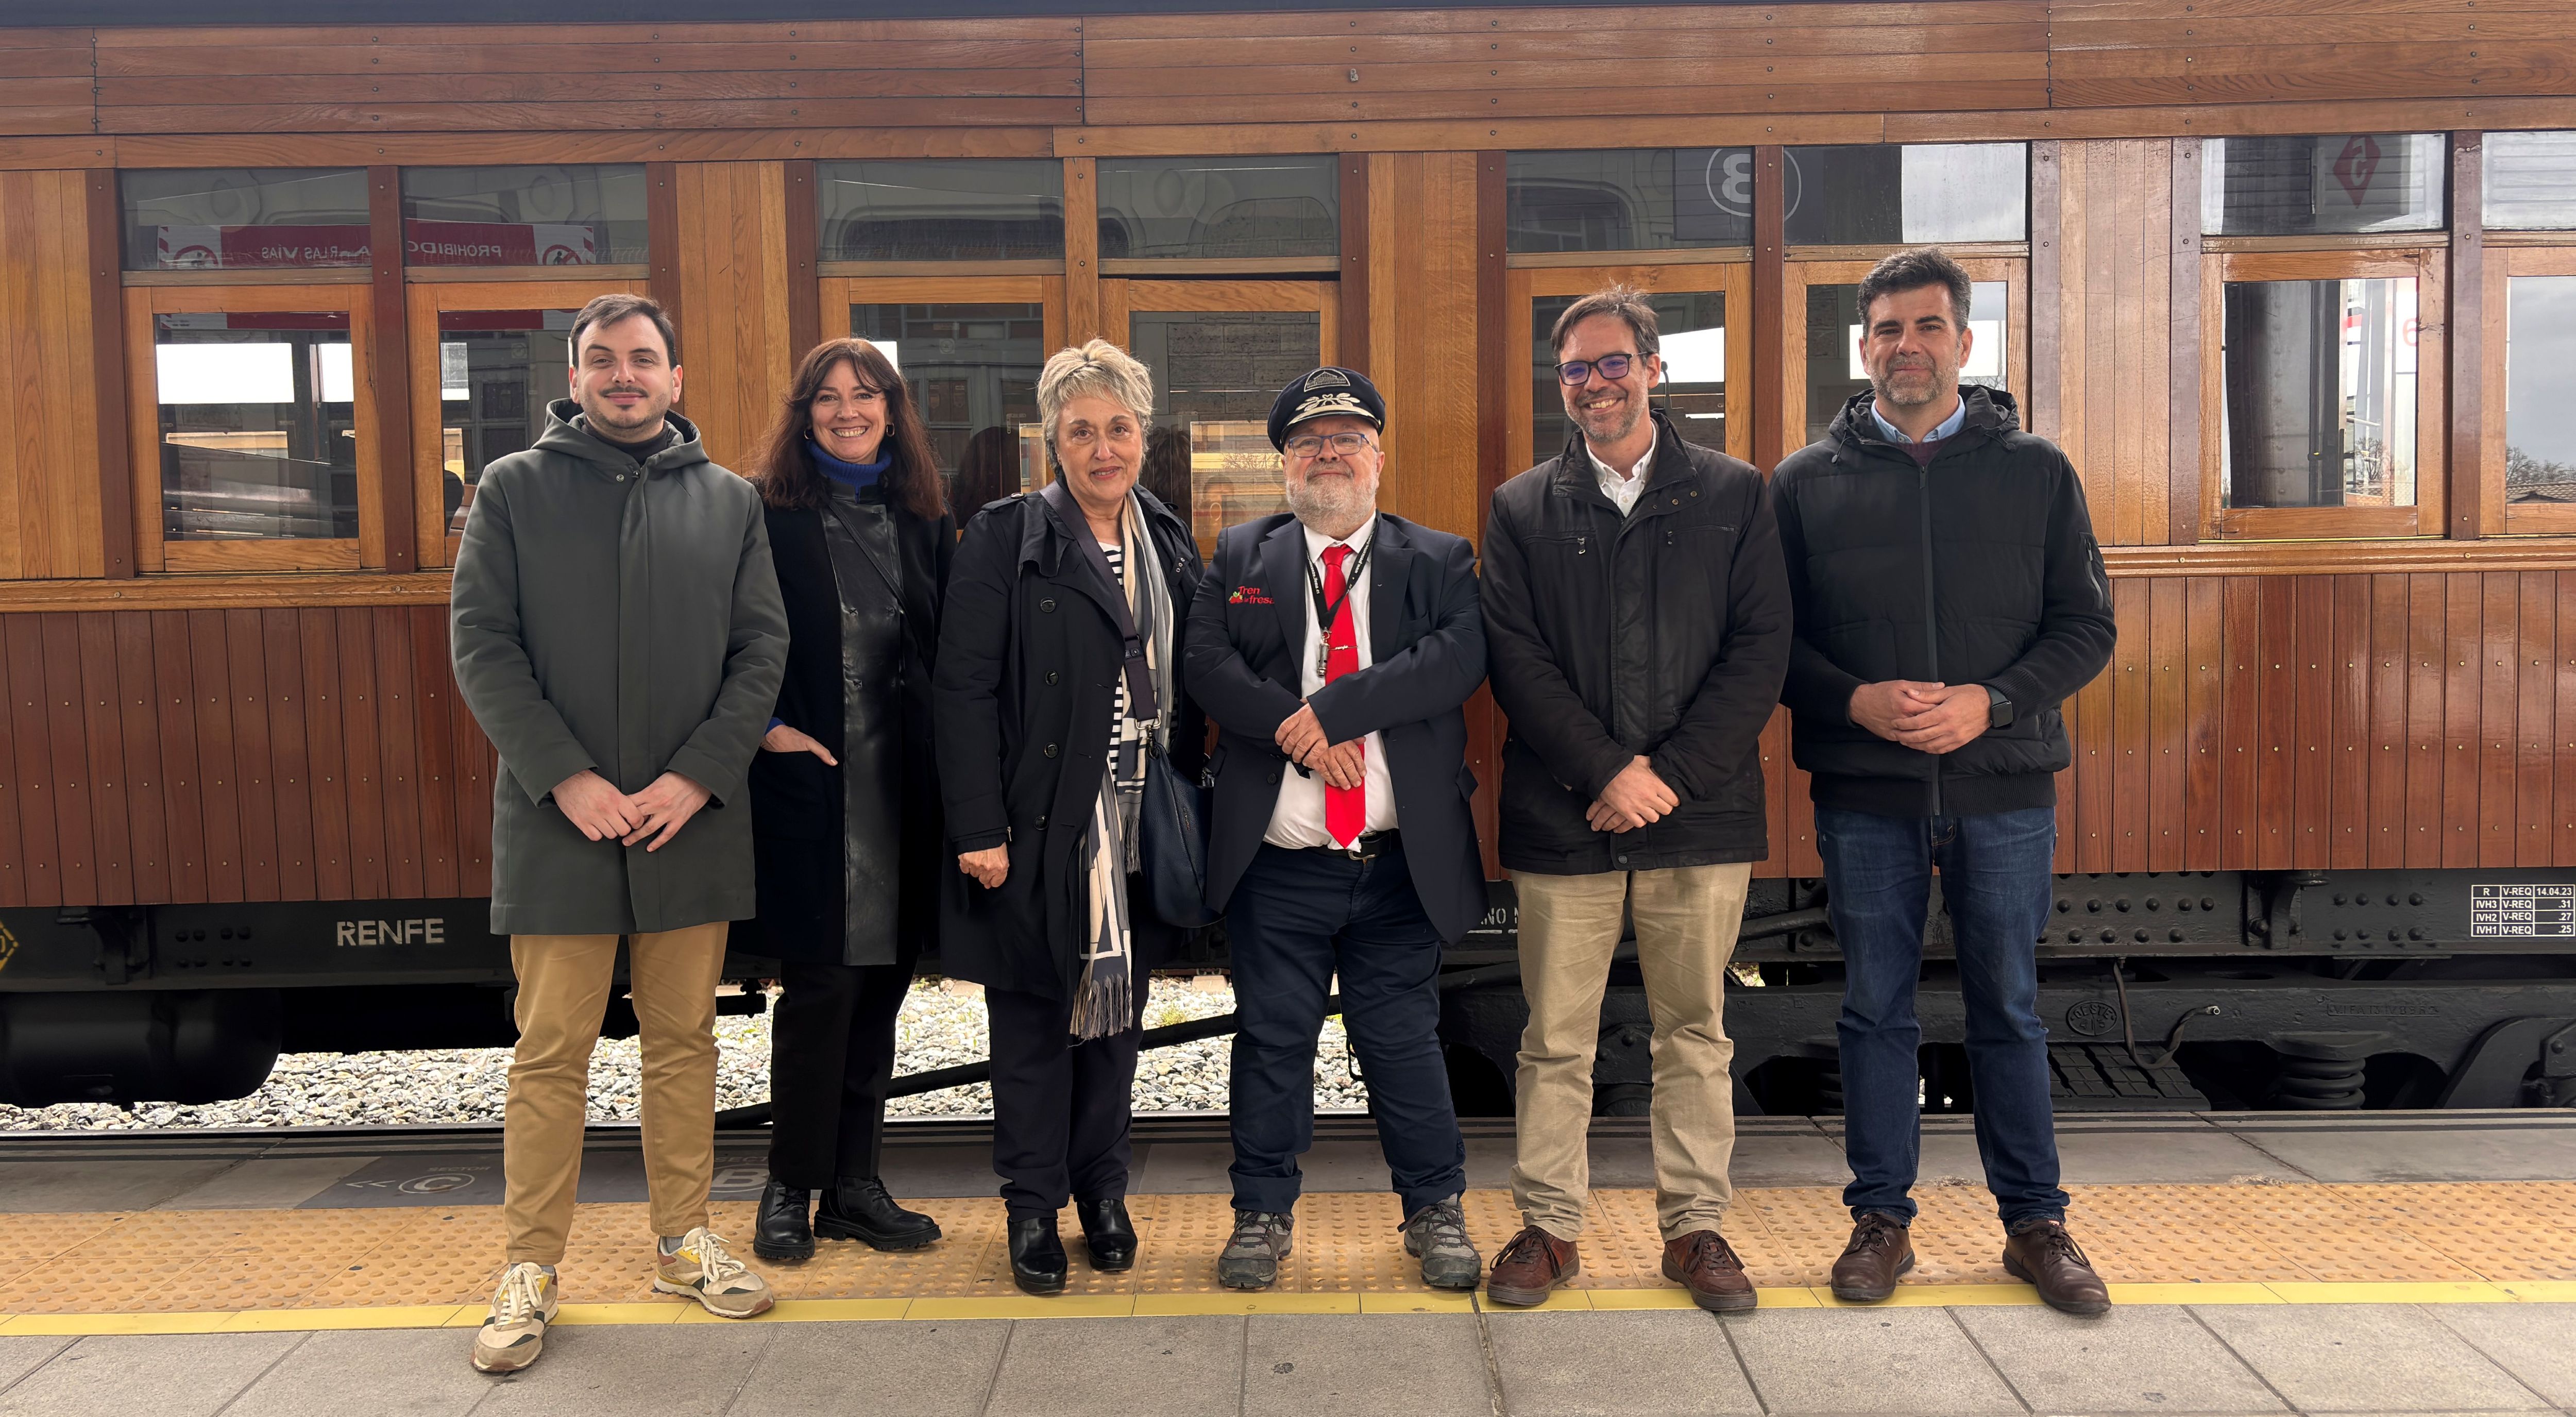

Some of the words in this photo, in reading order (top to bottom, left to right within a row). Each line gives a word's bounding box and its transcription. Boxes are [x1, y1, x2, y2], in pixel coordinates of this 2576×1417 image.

[1238, 585, 1260, 595] Tren
[2483, 887, 2490, 896] R
[2502, 887, 2532, 896] V-REQ
[2536, 887, 2572, 896] 14.04.23
[2476, 900, 2497, 908] IVH3
[2502, 900, 2532, 908] V-REQ
[2558, 900, 2571, 908] .31
[2476, 913, 2497, 921] IVH2
[2502, 912, 2532, 921] V-REQ
[336, 918, 445, 947] RENFE
[2477, 925, 2497, 934] IVH1
[2502, 925, 2532, 934] V-REQ
[2558, 925, 2571, 933] .25
[2073, 1004, 2113, 1020] OESTE
